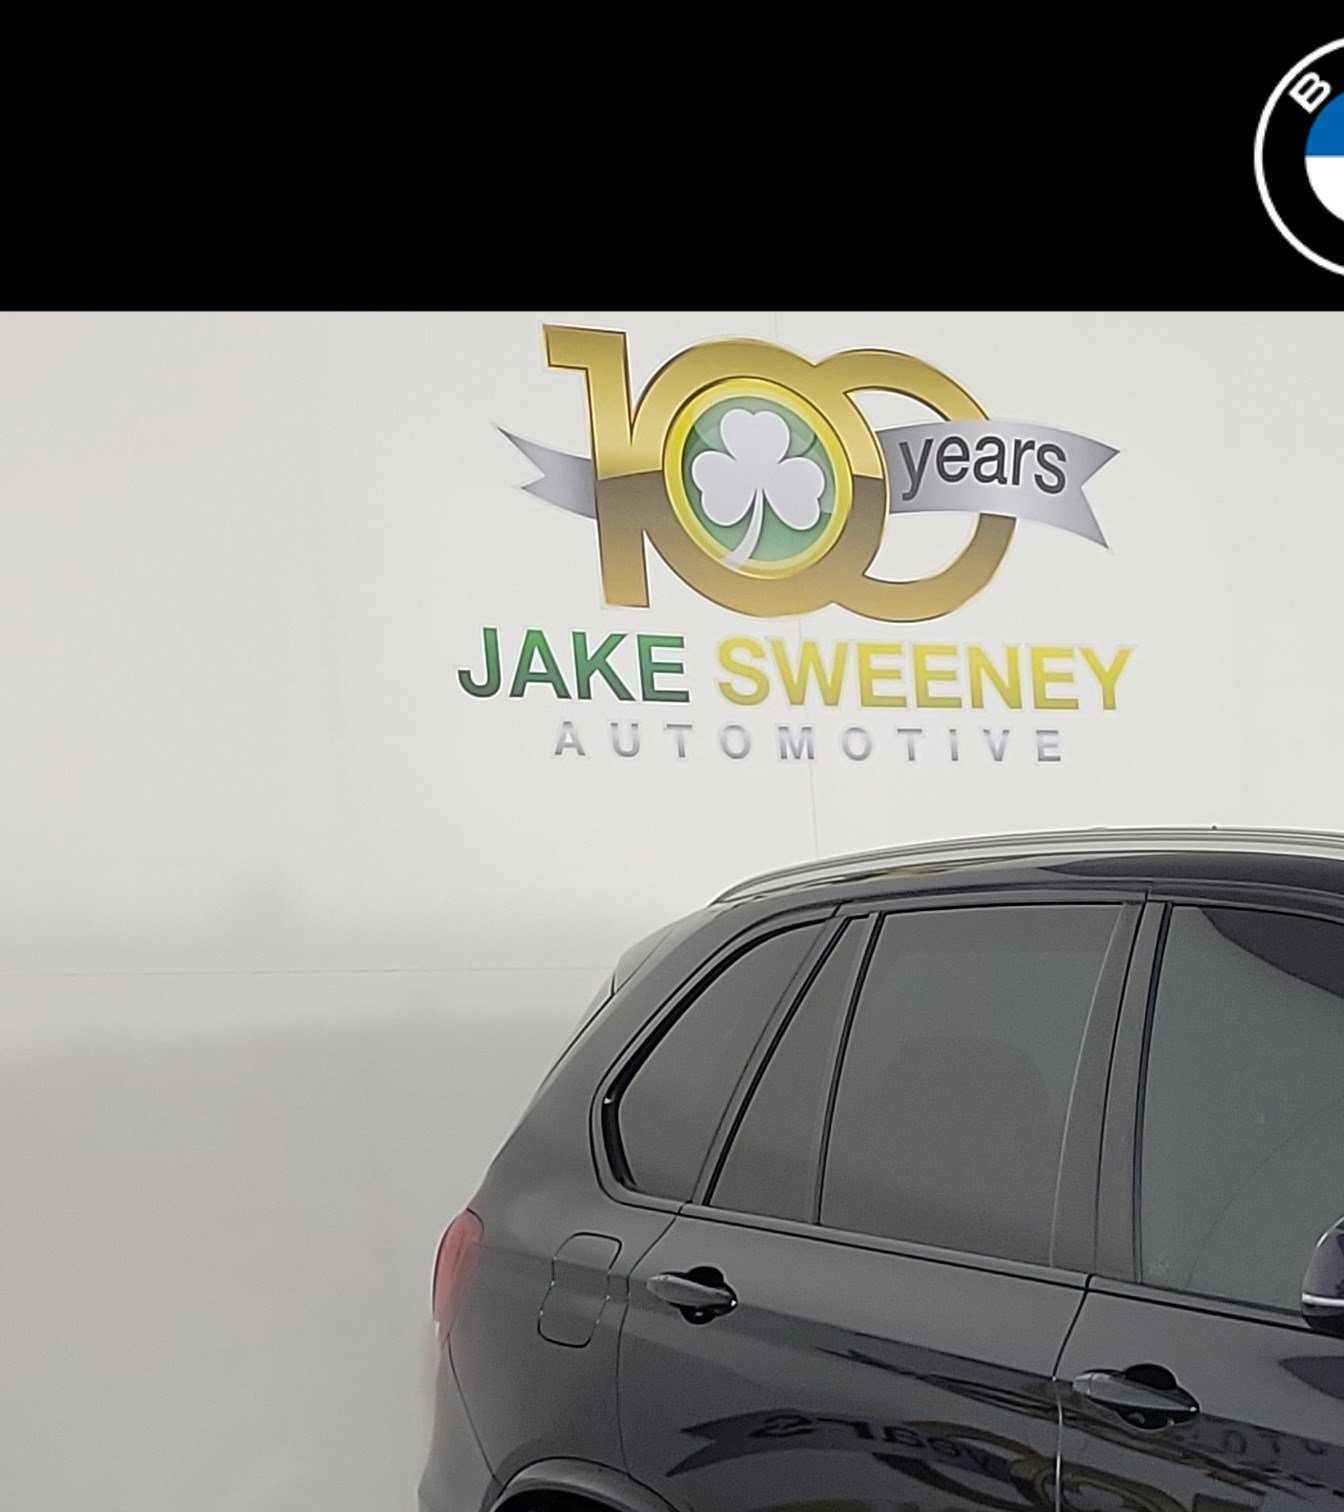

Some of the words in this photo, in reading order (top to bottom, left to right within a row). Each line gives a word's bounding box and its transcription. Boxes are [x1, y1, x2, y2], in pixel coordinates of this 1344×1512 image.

[543, 323, 1017, 623] 100
[899, 434, 1068, 501] years
[458, 627, 691, 703] JAKE
[716, 636, 1134, 712] SWEENEY
[554, 720, 1062, 763] AUTOMOTIVE
